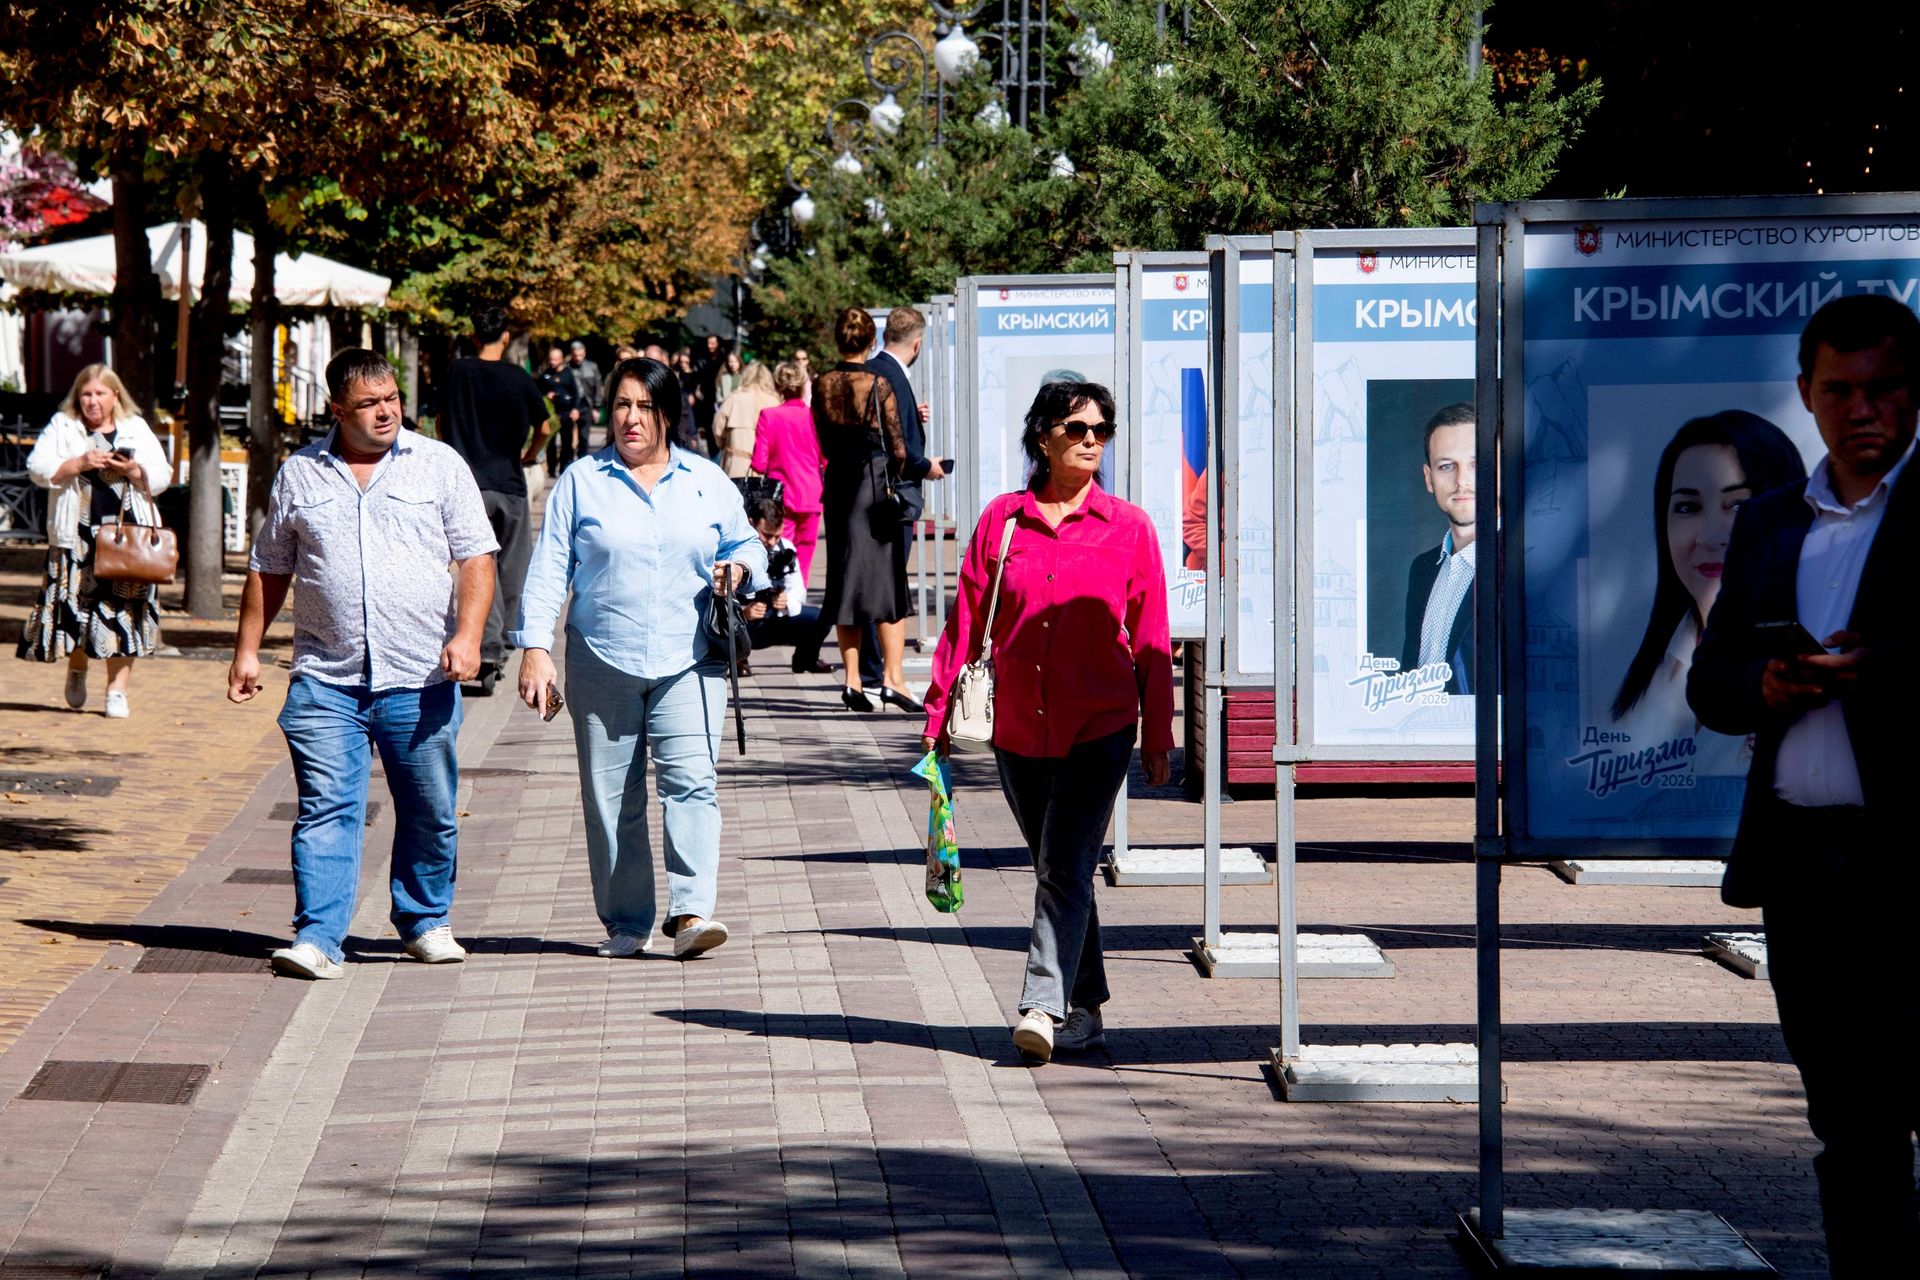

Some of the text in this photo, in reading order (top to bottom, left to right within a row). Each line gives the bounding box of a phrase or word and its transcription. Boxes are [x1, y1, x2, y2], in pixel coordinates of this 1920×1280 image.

[1615, 223, 1920, 249] МИНИСТЕРСТВО КУРОРТОВ
[1015, 288, 1090, 299] МИНИСТЕРСТВО
[1573, 271, 1843, 323] КРЫМСКИЙ
[998, 308, 1109, 330] КРЫМСКИЙ
[1172, 309, 1208, 332] КР
[1177, 568, 1206, 580] День
[1169, 581, 1206, 610] Тур
[1360, 654, 1399, 671] День
[1348, 664, 1450, 712] Туризма
[1421, 694, 1448, 705] 2026
[1582, 725, 1631, 746] День
[1568, 737, 1697, 798] Туризма
[1660, 774, 1695, 787] 2026
